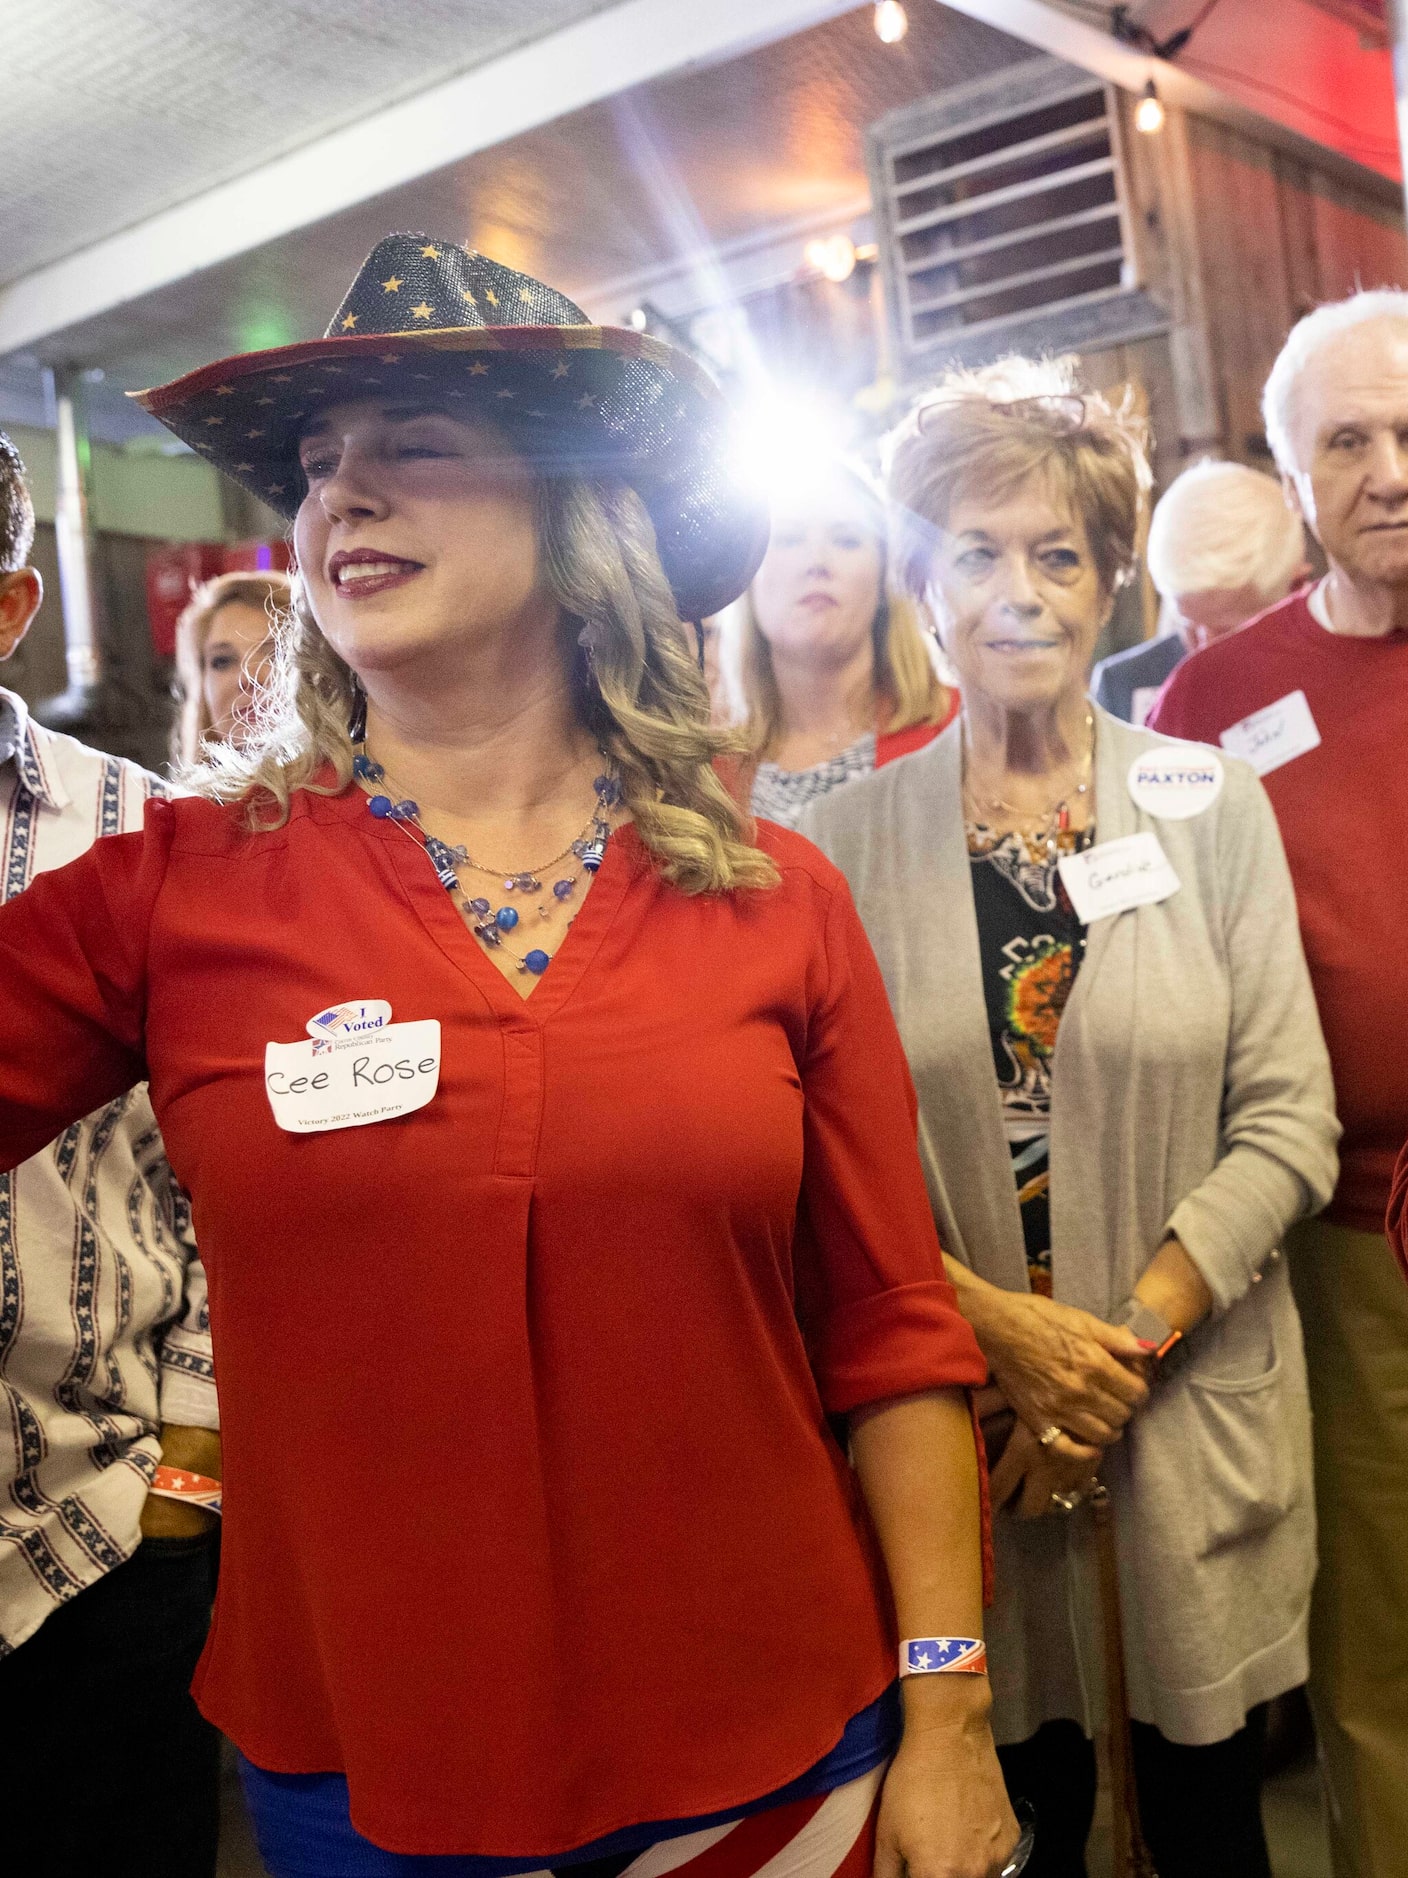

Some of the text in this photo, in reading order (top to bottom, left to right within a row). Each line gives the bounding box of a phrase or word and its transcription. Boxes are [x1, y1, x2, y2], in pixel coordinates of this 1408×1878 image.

[1137, 772, 1214, 783] PAXTON
[359, 1007, 366, 1019] I
[343, 1016, 383, 1033] Voted
[334, 1036, 393, 1051] Republican Party
[267, 1056, 438, 1095] Cee Rose
[298, 1103, 403, 1127] Victory 2022 Watch Party
